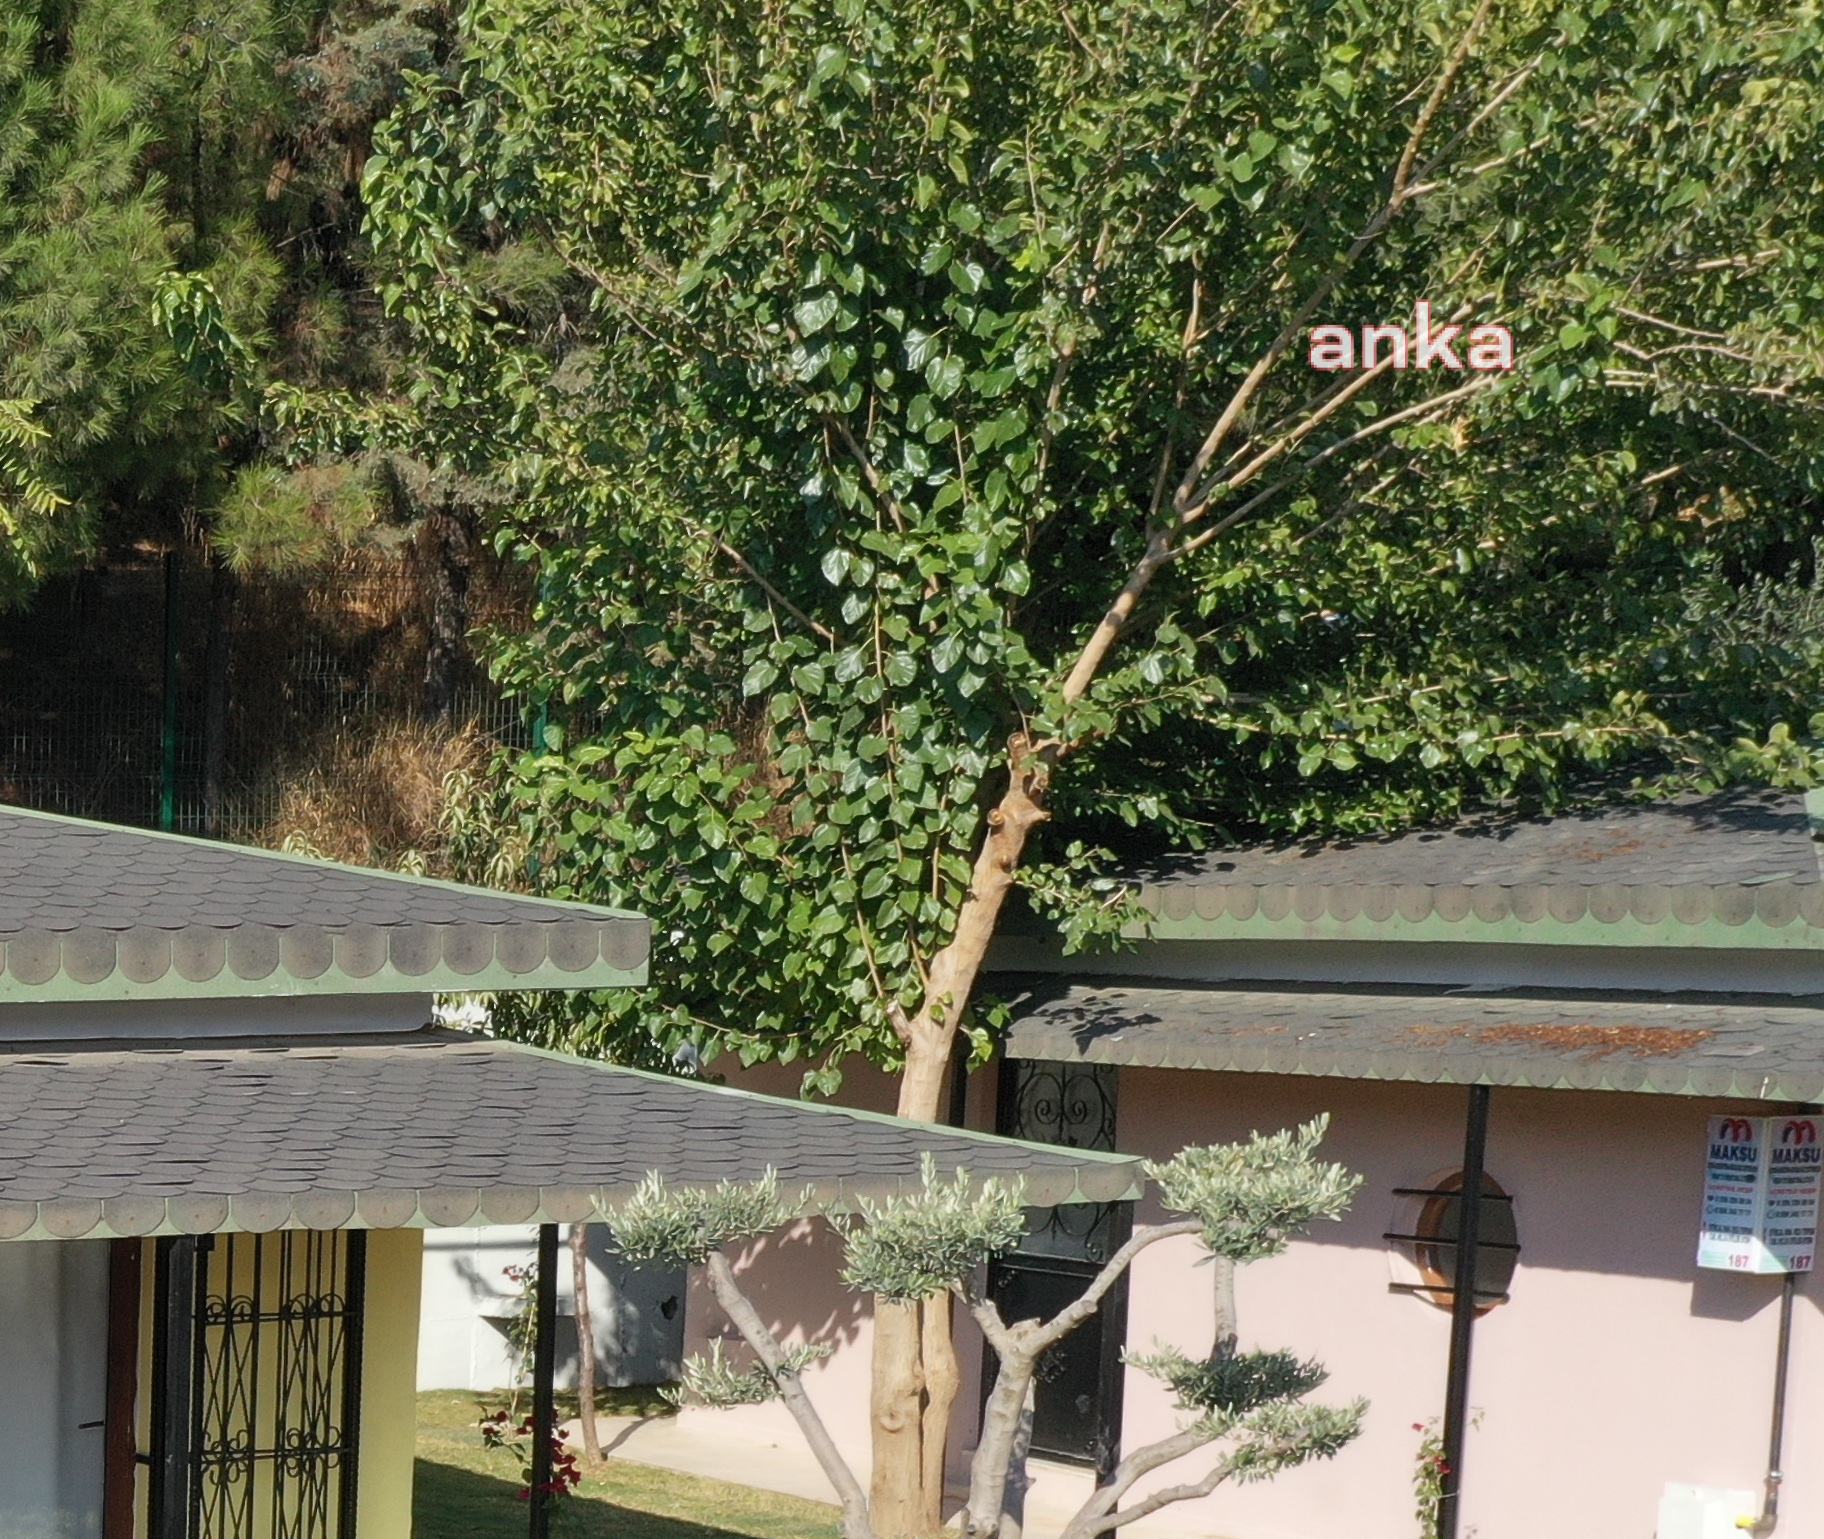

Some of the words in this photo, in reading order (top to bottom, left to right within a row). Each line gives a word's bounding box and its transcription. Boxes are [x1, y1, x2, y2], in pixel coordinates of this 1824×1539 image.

[1710, 1144, 1758, 1163] MAKSU
[1771, 1147, 1821, 1165] MAKSU
[1728, 1254, 1749, 1268] 187
[1789, 1255, 1811, 1270] 187
